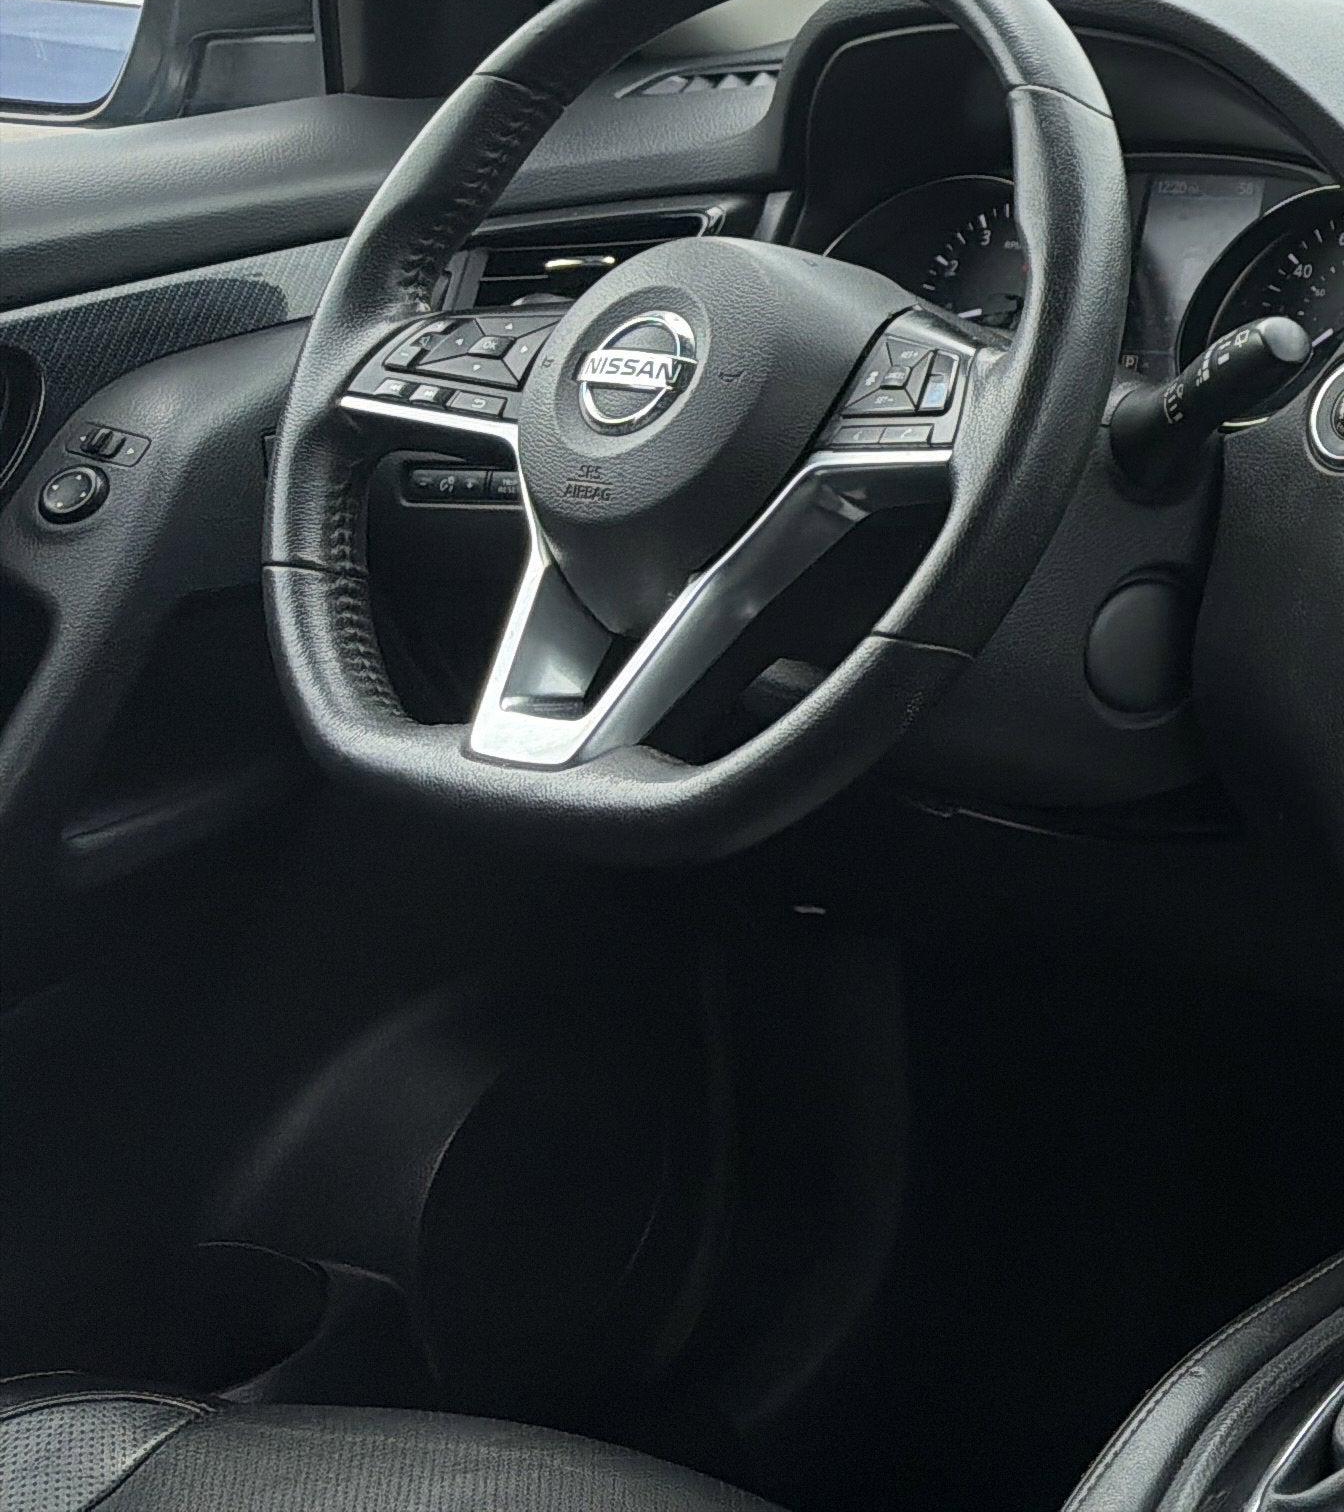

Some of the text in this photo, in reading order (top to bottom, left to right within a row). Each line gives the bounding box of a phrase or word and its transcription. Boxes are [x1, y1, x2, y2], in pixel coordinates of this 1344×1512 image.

[981, 230, 992, 246] 3
[1293, 264, 1313, 279] 40
[483, 340, 497, 350] OK
[584, 357, 682, 384] NISSAN
